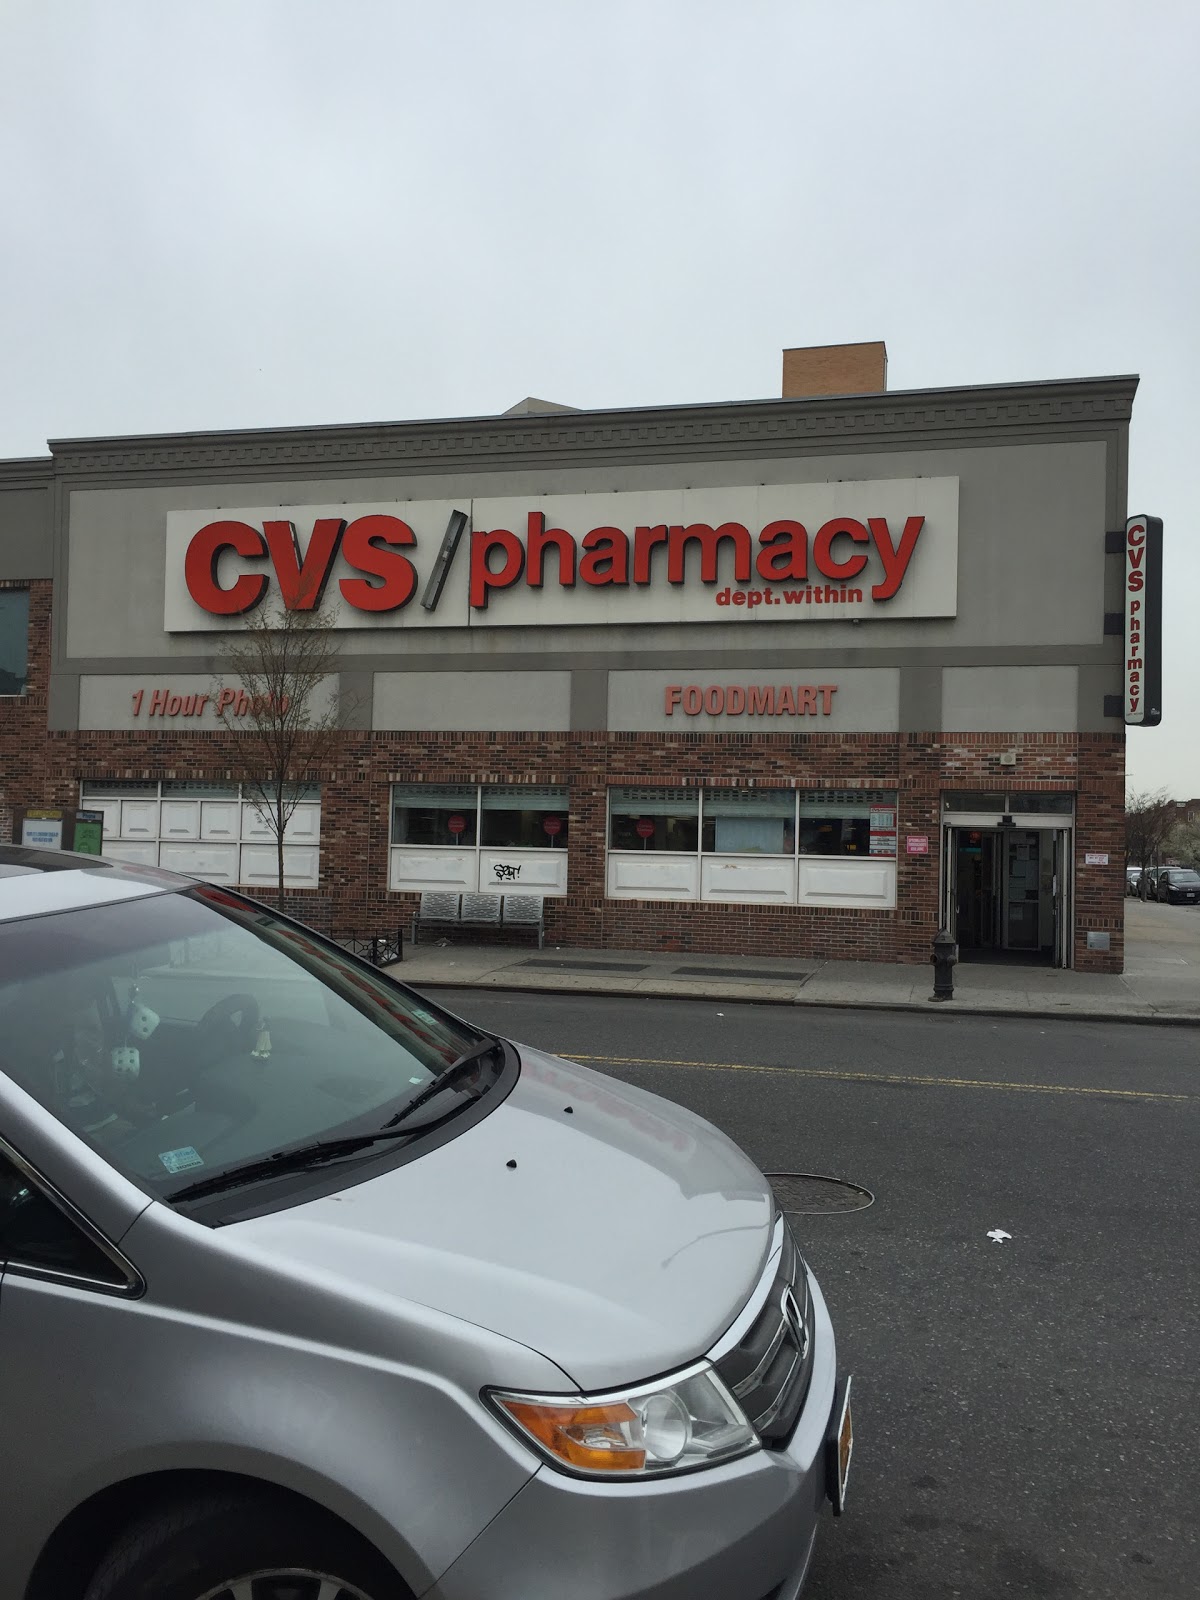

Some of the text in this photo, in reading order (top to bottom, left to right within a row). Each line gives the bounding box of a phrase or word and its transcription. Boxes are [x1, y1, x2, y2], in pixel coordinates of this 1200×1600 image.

[1127, 524, 1145, 592] CVS
[1127, 600, 1143, 712] pharmacy
[132, 689, 144, 716] 1
[149, 688, 209, 716] Hour
[665, 684, 837, 716] FOODMART
